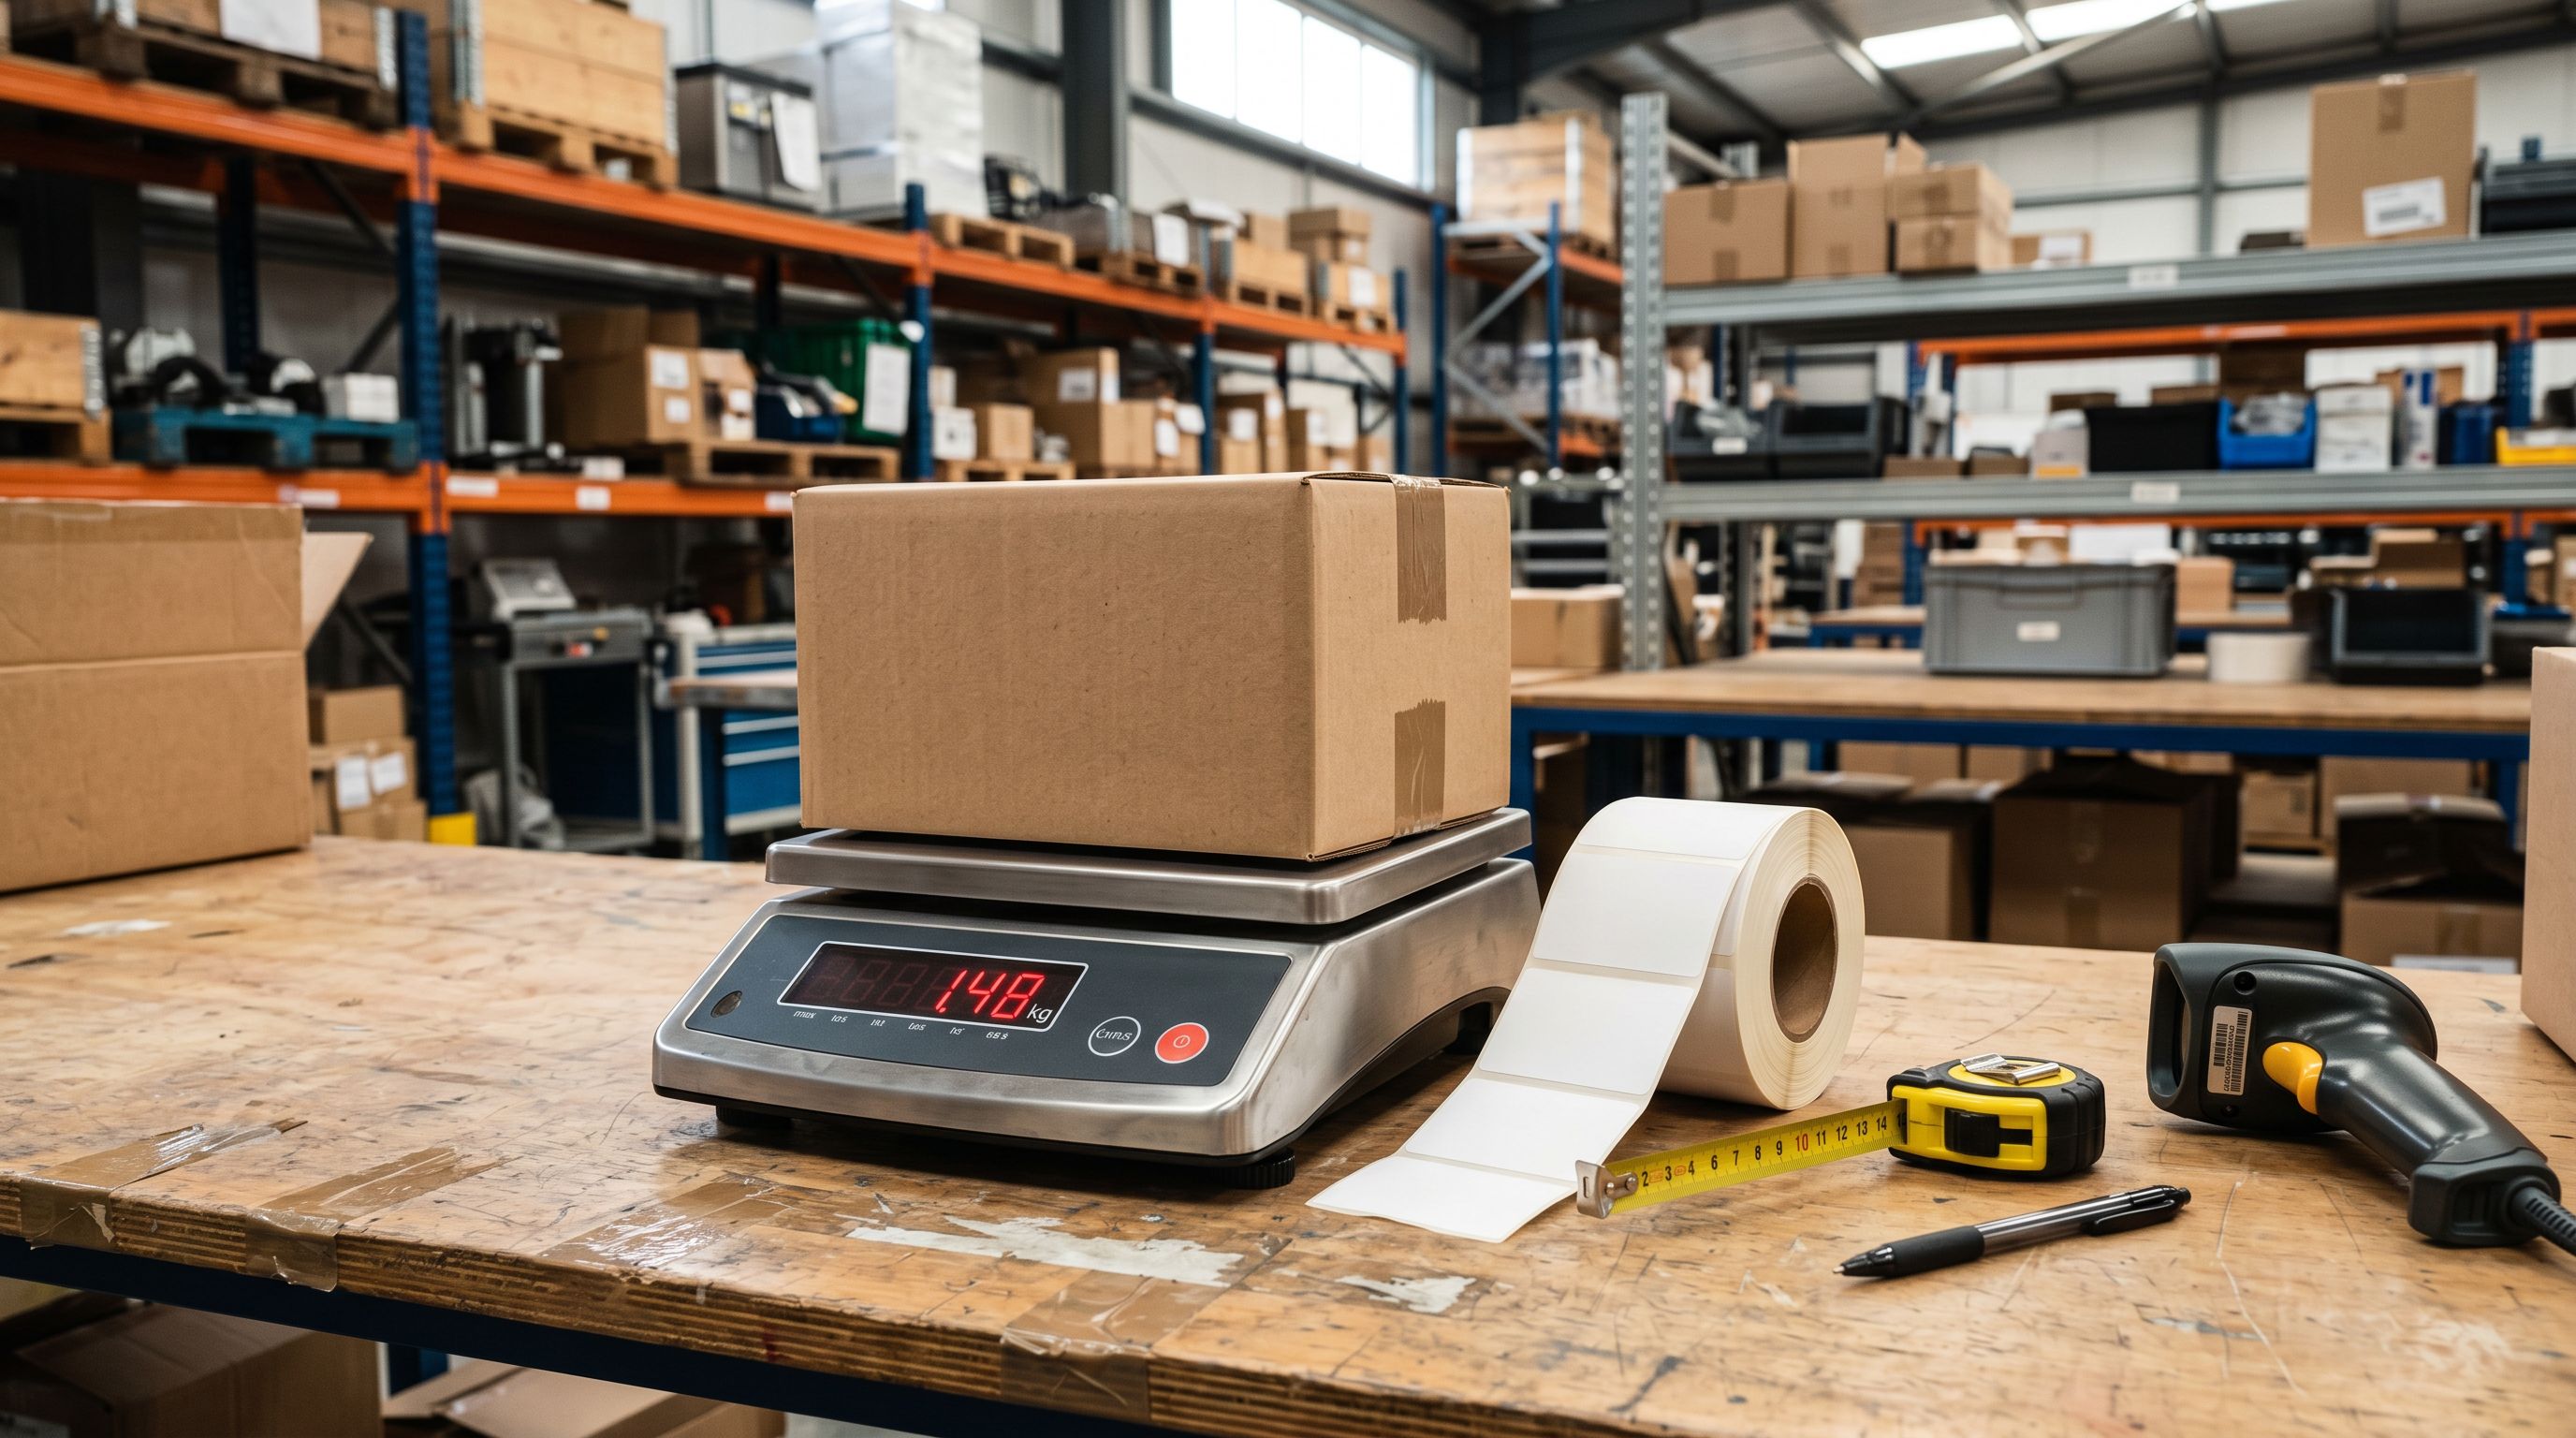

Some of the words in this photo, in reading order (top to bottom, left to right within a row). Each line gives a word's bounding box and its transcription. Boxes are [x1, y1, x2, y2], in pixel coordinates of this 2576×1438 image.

[935, 969, 1046, 1020] 1.48
[1026, 1004, 1053, 1023] kg
[1641, 1171, 1649, 1187] 2
[1664, 1166, 1672, 1181] 3
[1688, 1160, 1695, 1176] 4
[1711, 1154, 1718, 1170] 6
[1733, 1150, 1739, 1167] 7
[1754, 1145, 1762, 1161] 8
[1776, 1140, 1783, 1156] 9
[1795, 1133, 1809, 1152] 10
[1816, 1130, 1826, 1147] 11
[1836, 1125, 1848, 1141] 12
[1856, 1121, 1868, 1137] 13
[1876, 1115, 1887, 1132] 14
